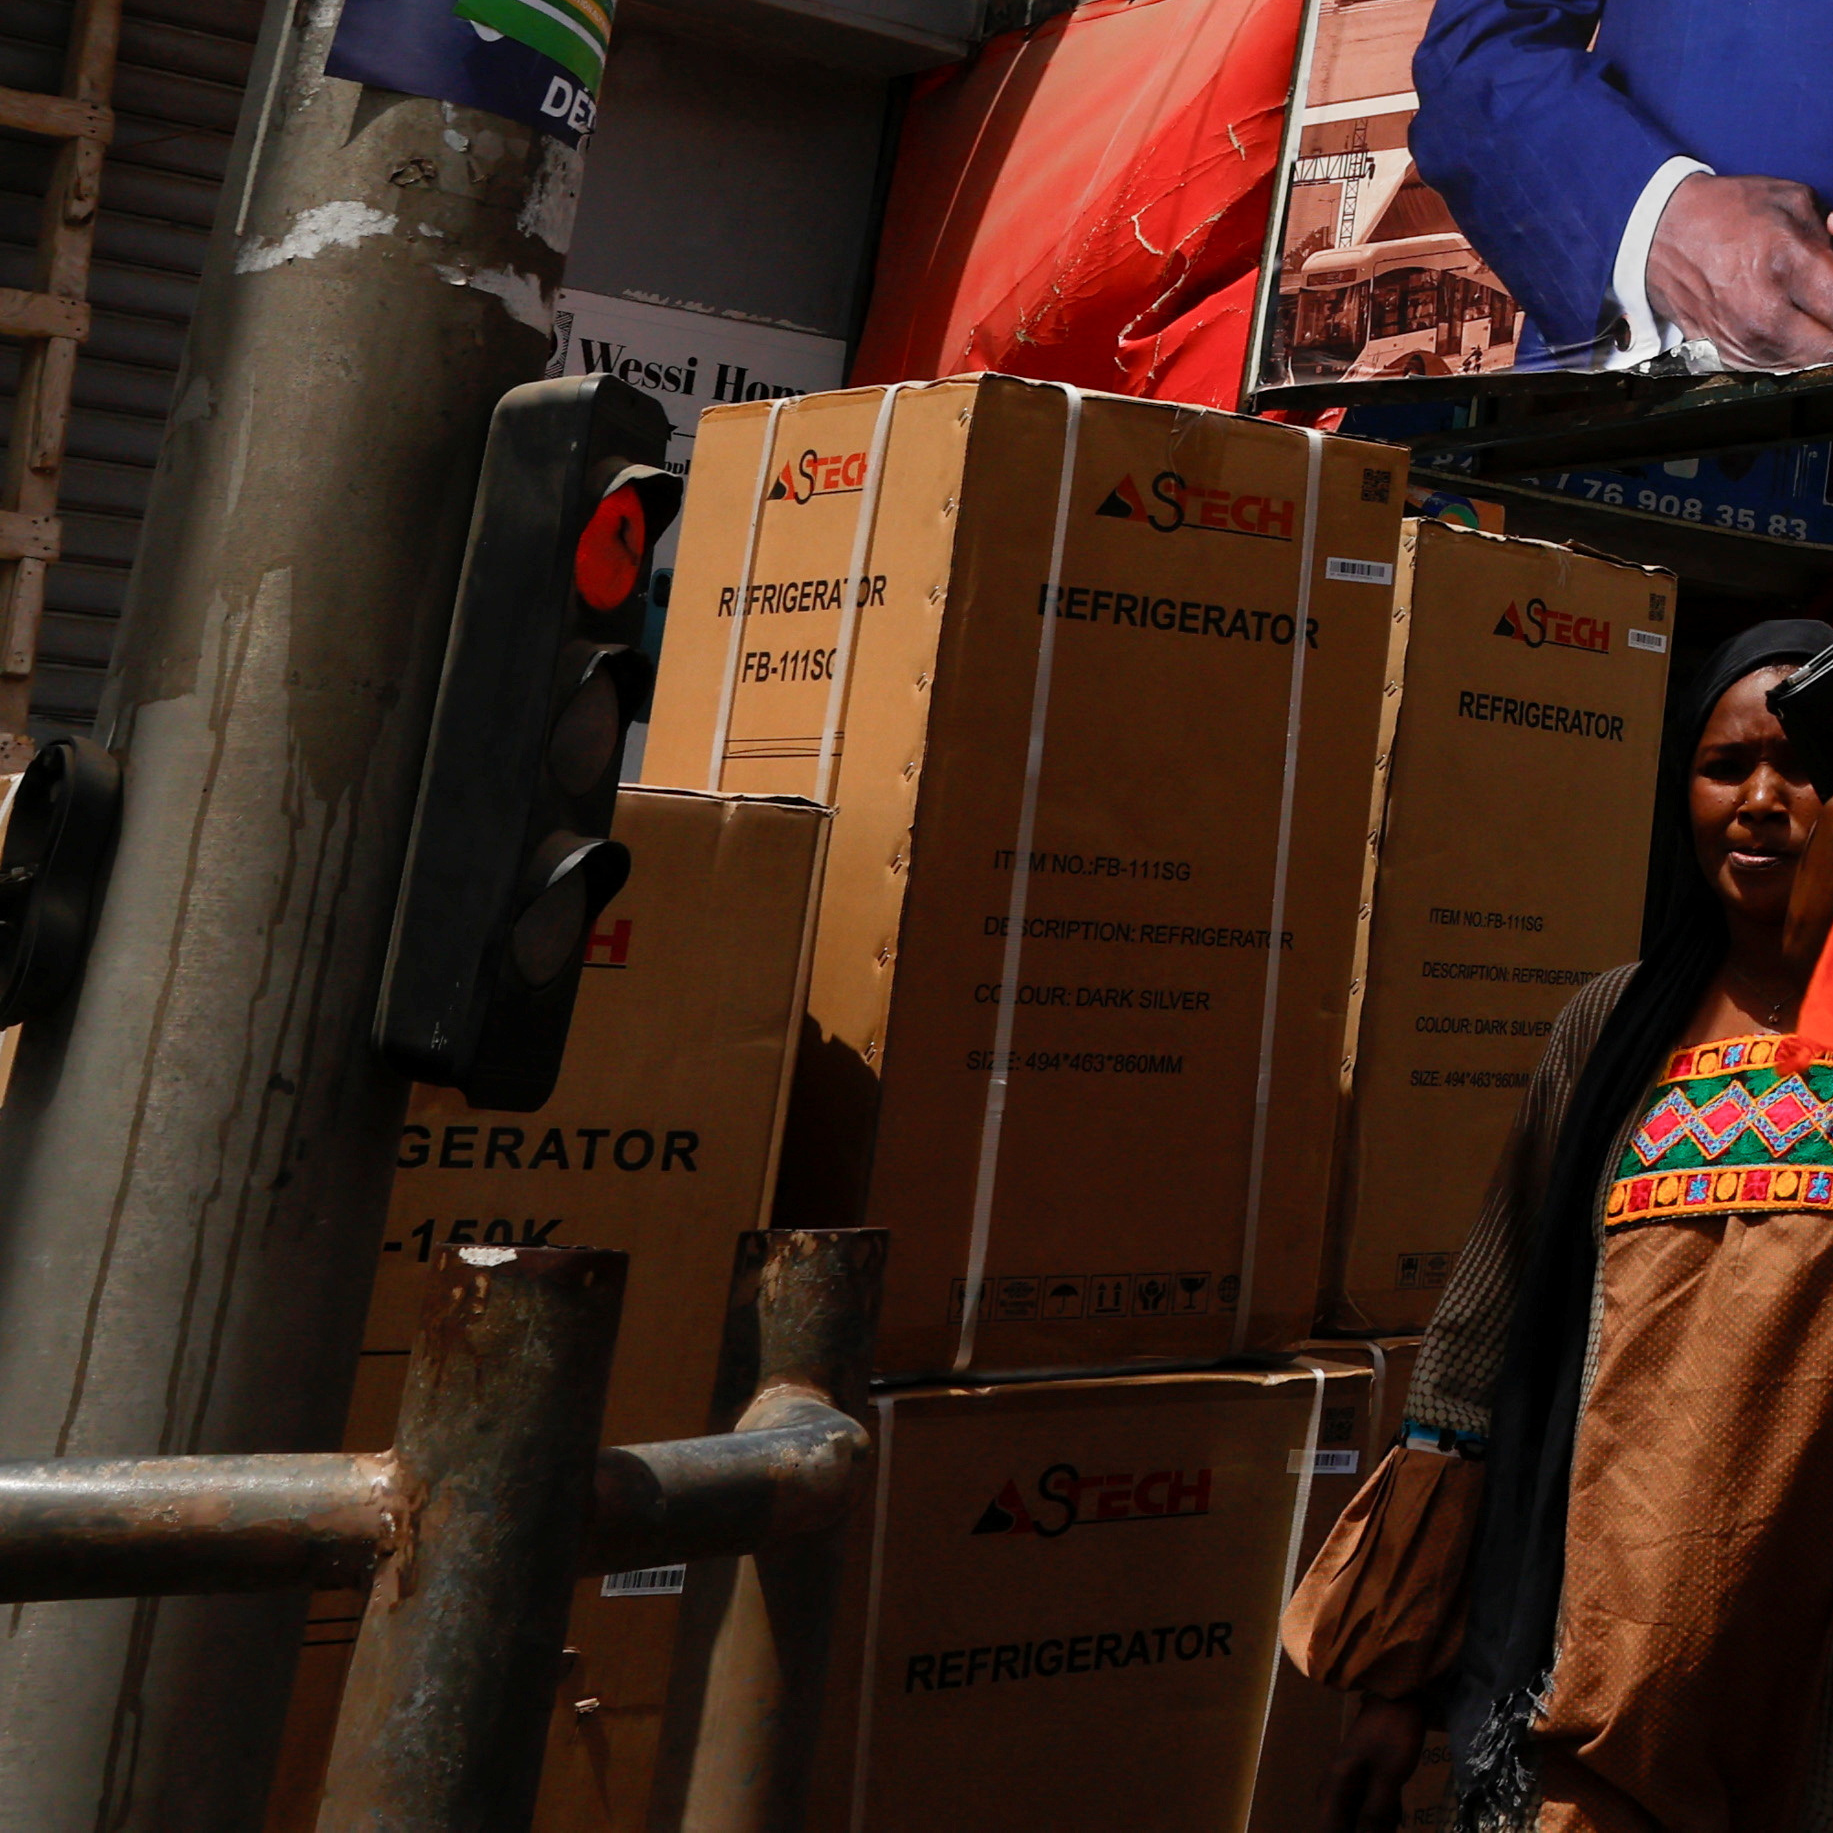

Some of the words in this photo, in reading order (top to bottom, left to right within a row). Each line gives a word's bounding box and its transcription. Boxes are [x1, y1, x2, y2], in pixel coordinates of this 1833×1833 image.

[579, 338, 698, 396] Wessi
[711, 363, 808, 403] Hom
[1095, 471, 1295, 541] ASTECH
[1582, 478, 1625, 505] 76
[1637, 489, 1703, 521] 908
[1715, 504, 1755, 532] 35
[1767, 514, 1808, 541] 83
[718, 574, 888, 618] REFRIGERAOR
[1037, 582, 1320, 650] REFRIGERATOR
[1492, 598, 1611, 655] ASTECH
[1458, 690, 1624, 742] REFRIGERATOR
[993, 850, 1047, 873] ITM
[1429, 907, 1462, 928] ITEM
[974, 983, 1071, 1008] COOUR:
[1076, 987, 1133, 1009] DARK
[1140, 988, 1210, 1012] SILVER
[1421, 962, 1510, 984] DESCRIPTION:
[1511, 966, 1603, 987] REFRIGERATO
[1415, 1016, 1473, 1036] COLOUR:
[1474, 1018, 1508, 1037] DARK
[1511, 1020, 1552, 1039] SILVER
[1410, 1070, 1443, 1088] SIZE:
[396, 1124, 700, 1173] GERATOR
[970, 1463, 1212, 1538] ASTECH
[904, 1620, 1233, 1694] REFRIGERATOR
